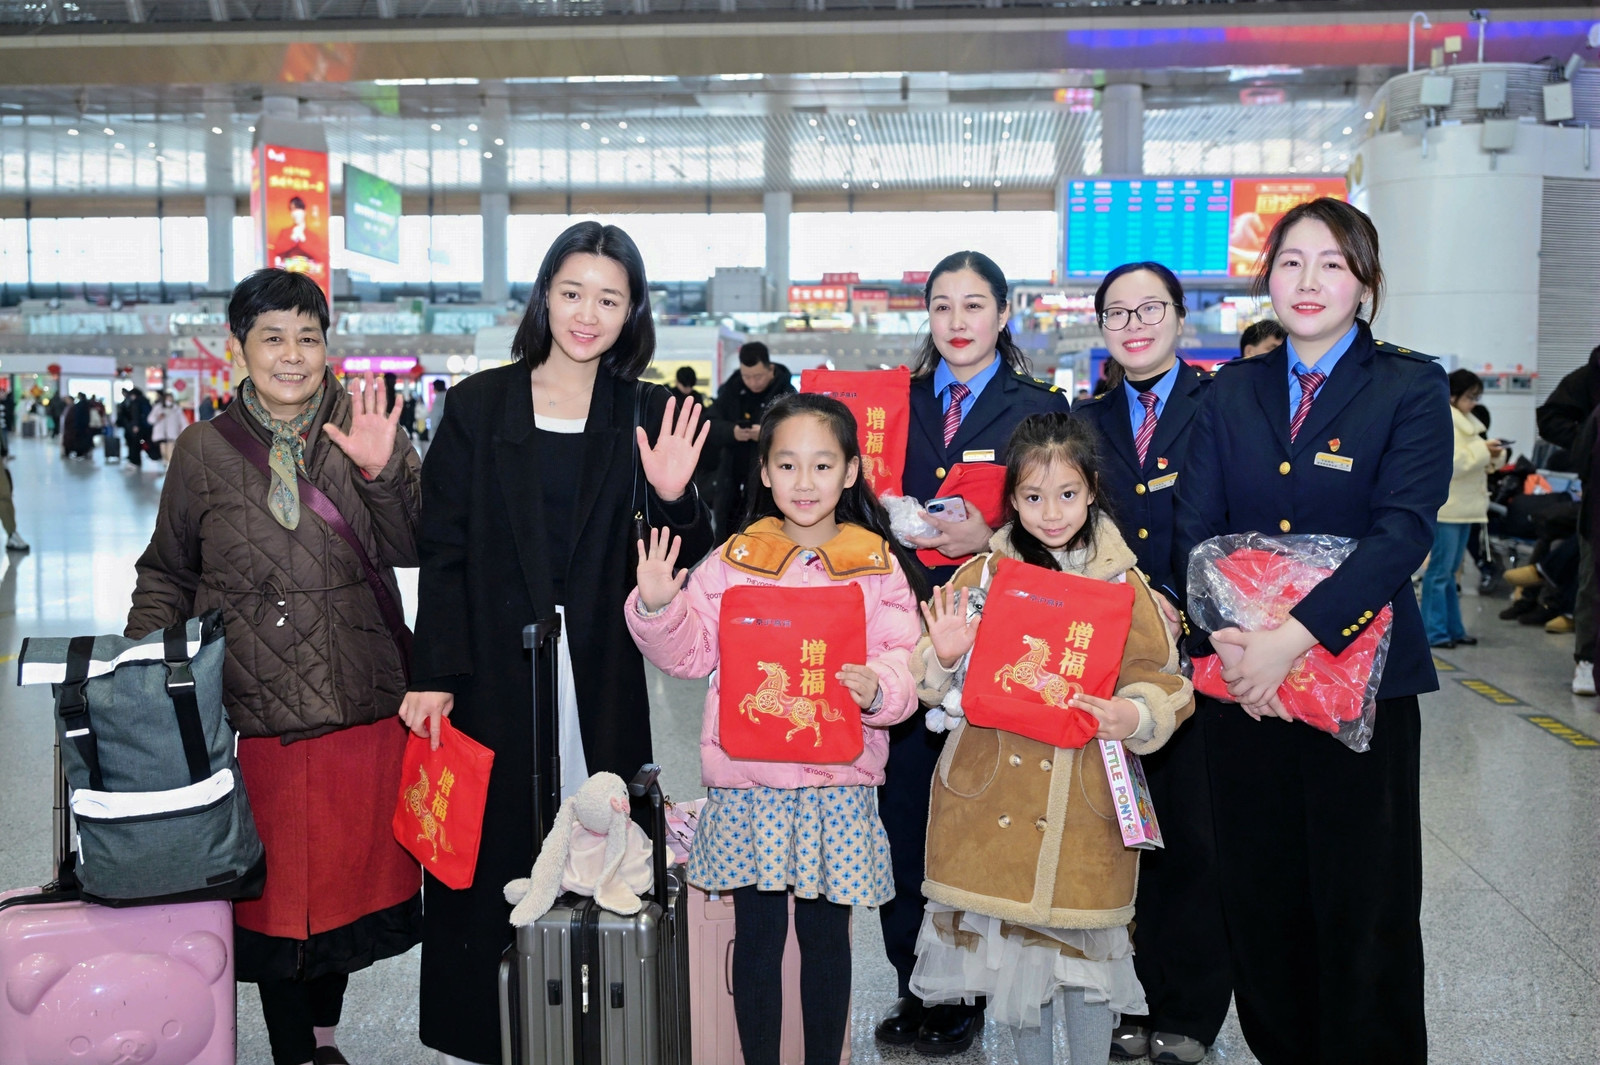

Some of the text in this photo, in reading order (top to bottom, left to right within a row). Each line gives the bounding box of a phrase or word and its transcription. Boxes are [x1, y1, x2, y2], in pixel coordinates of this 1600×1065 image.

[865, 407, 886, 454] 增福
[800, 638, 827, 696] 增福
[1059, 620, 1095, 679] 增福
[432, 765, 455, 822] 增福
[1116, 785, 1134, 822] PONY
